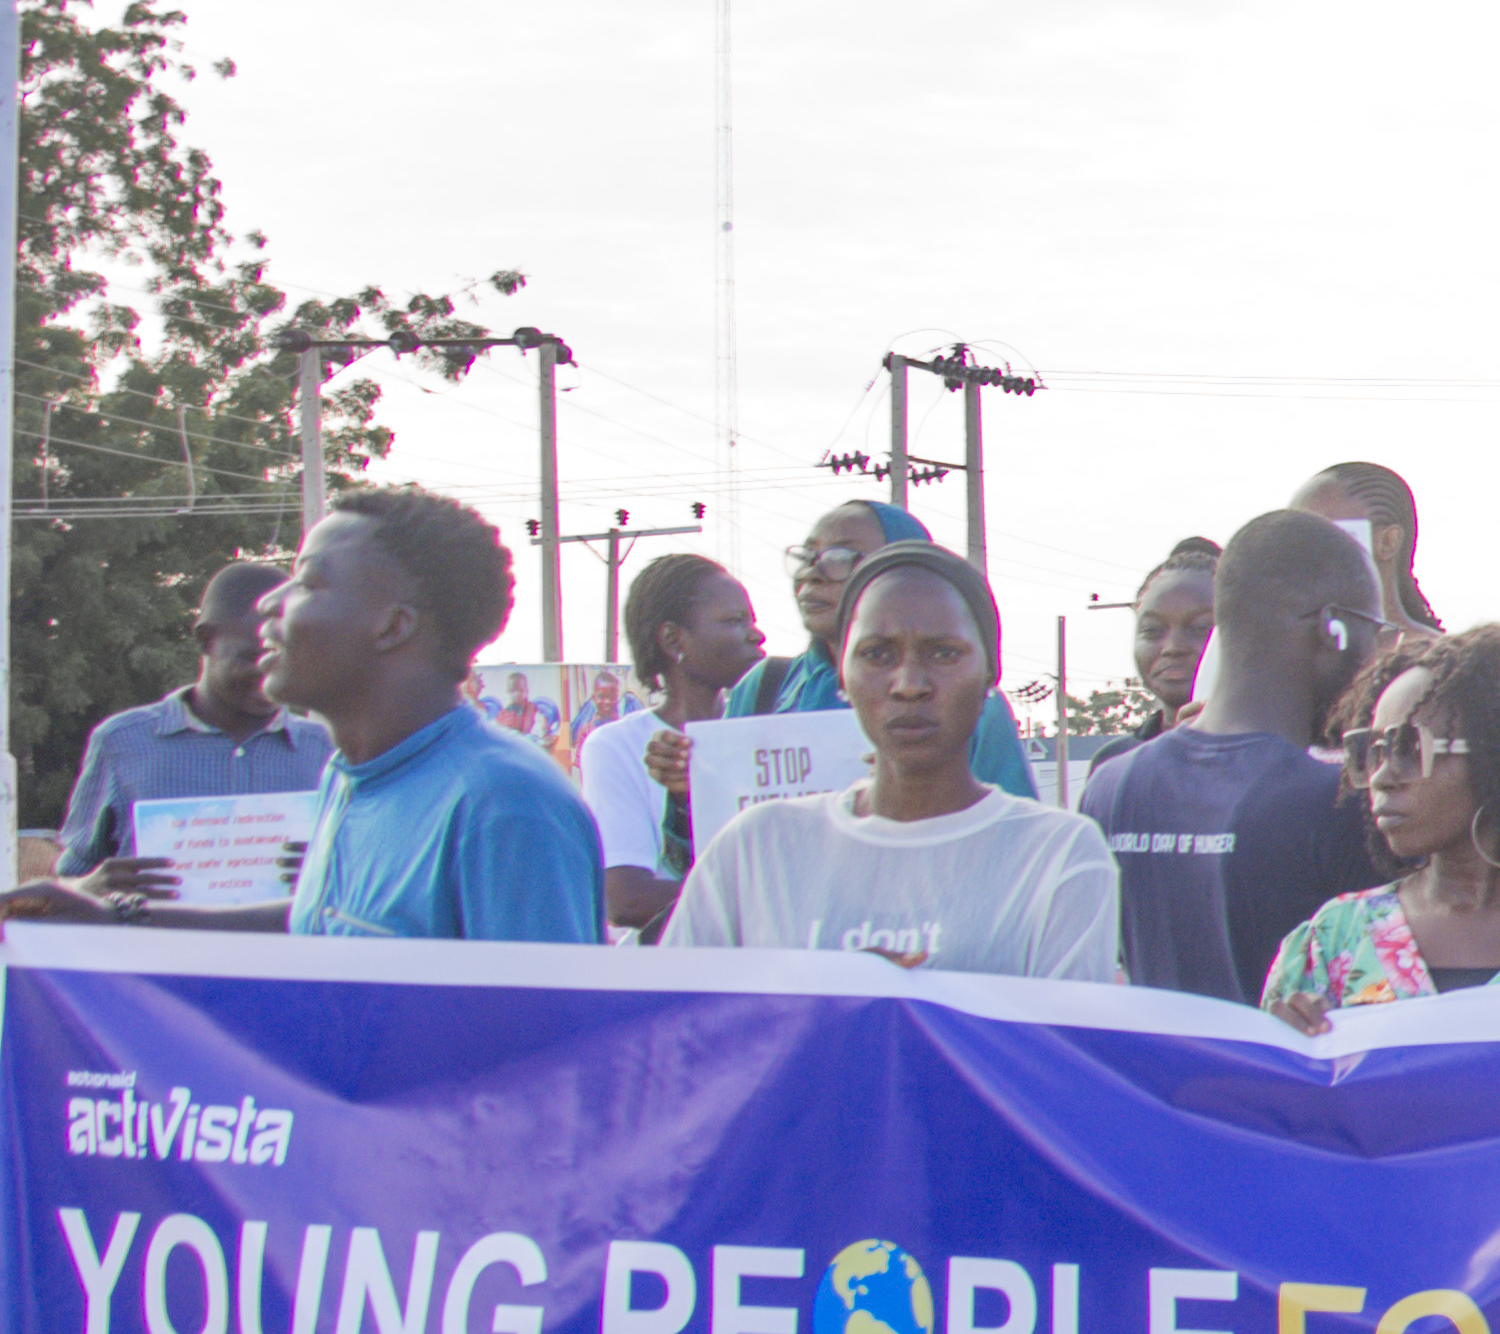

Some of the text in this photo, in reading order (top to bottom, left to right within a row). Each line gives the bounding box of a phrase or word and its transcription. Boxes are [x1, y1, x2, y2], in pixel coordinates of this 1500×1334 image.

[755, 747, 812, 787] STOP
[1178, 834, 1193, 853] OF
[843, 921, 942, 954] don't
